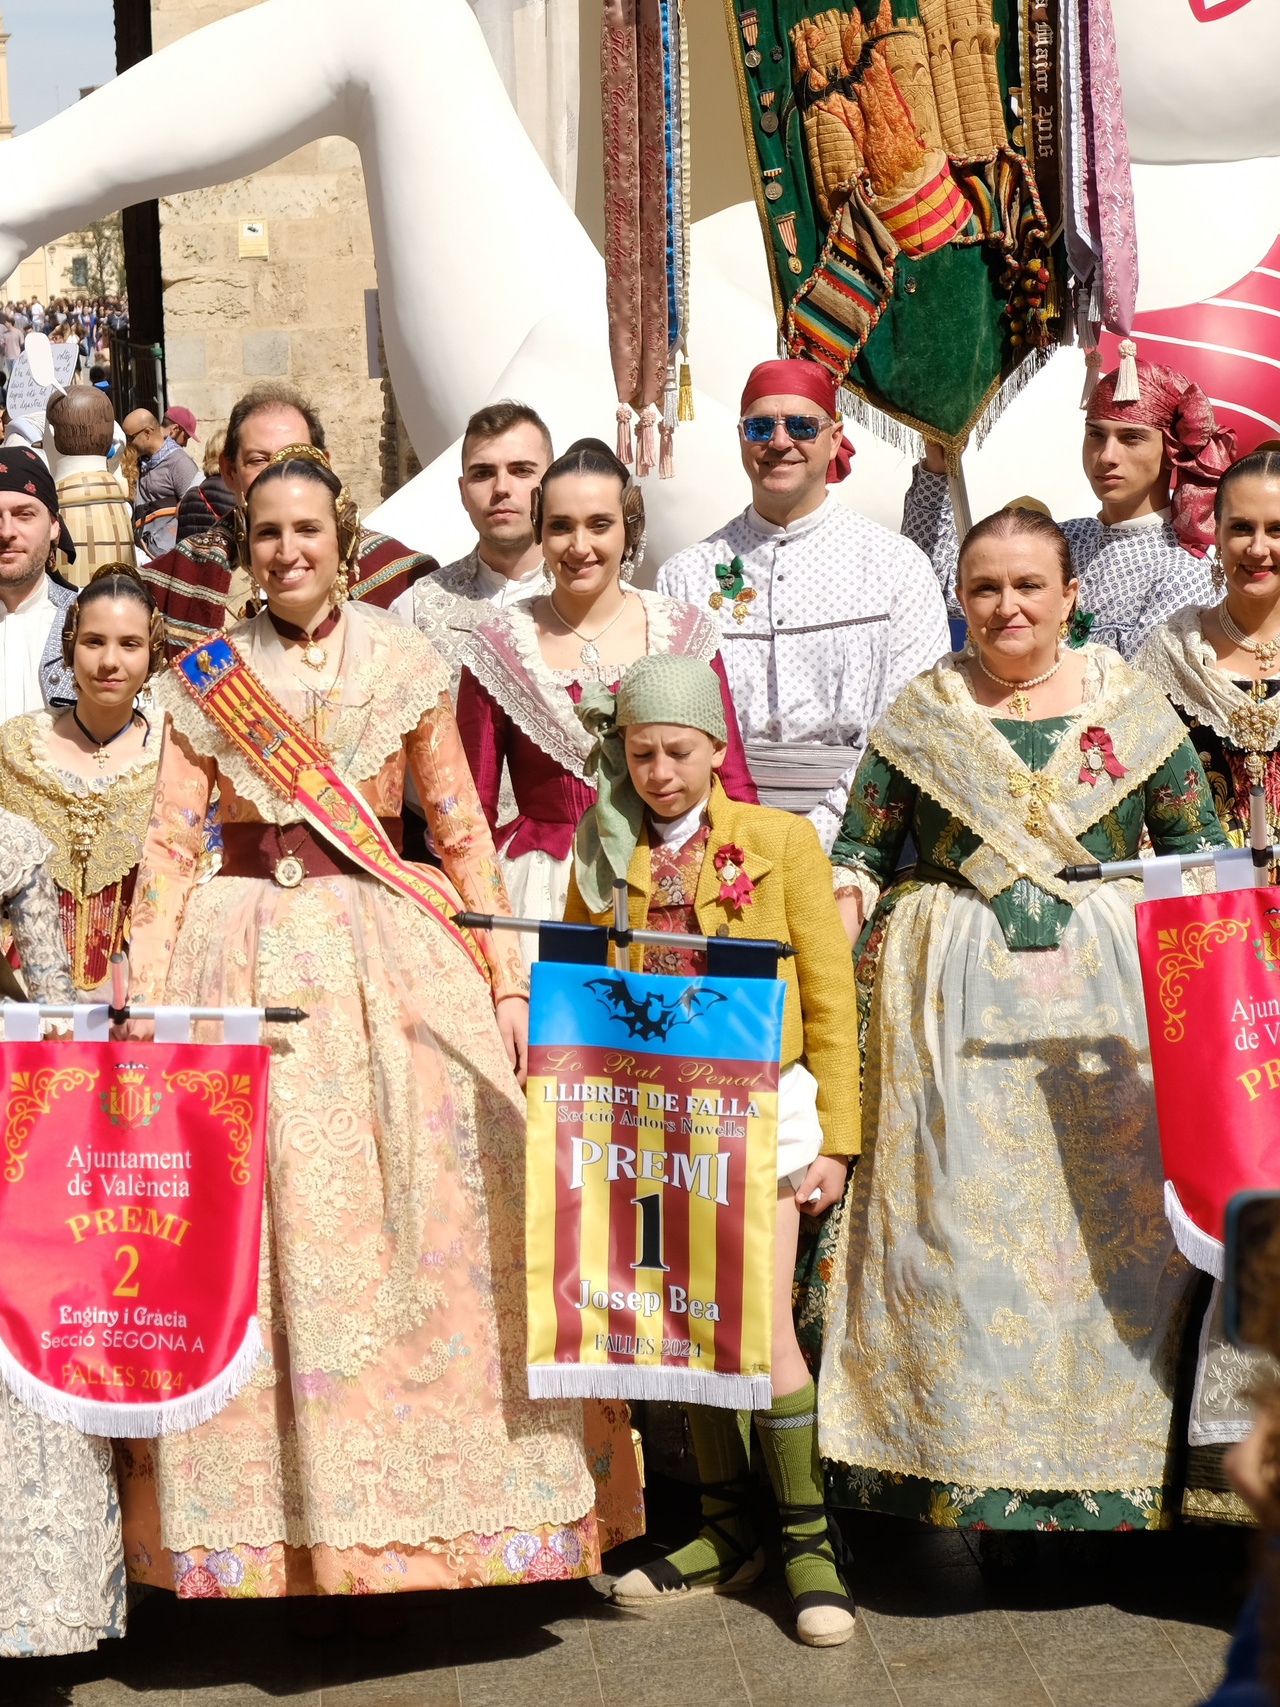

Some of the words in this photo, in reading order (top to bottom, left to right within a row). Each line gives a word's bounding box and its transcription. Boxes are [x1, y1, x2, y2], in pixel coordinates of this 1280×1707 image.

[609, 27, 625, 75] Flor
[643, 24, 655, 112] Fallera
[1032, 22, 1055, 93] Major
[1036, 105, 1054, 158] 2016
[1101, 76, 1116, 169] Romero
[1108, 179, 1125, 247] Prats
[609, 192, 628, 281] Sánchez
[646, 221, 655, 267] 2019
[1234, 1026, 1260, 1051] de
[543, 1050, 583, 1074] Lo
[603, 1052, 663, 1080] Rat
[678, 1061, 765, 1088] Penat
[544, 1083, 639, 1107] LLIBRET
[648, 1090, 679, 1113] DE
[685, 1095, 760, 1118] FALLA
[558, 1105, 615, 1125] Secció
[620, 1113, 676, 1133] Autors
[681, 1117, 745, 1138] Novells
[66, 1145, 192, 1174] Ajuntament
[569, 1135, 731, 1207] PREMI
[67, 1174, 91, 1196] de
[99, 1174, 191, 1198] València
[64, 1205, 193, 1247] PREMI
[629, 1192, 671, 1272] 1
[113, 1245, 140, 1298] 2
[60, 1305, 119, 1329] Enginy
[123, 1306, 129, 1324] i
[133, 1305, 187, 1328] Gràcia
[574, 1279, 662, 1318] Josep
[669, 1284, 721, 1323] Bea
[41, 1330, 95, 1350] Secció
[102, 1331, 187, 1352] SEGONA
[191, 1336, 205, 1353] A
[595, 1332, 657, 1356] FALLES
[661, 1337, 703, 1358] 2024
[62, 1363, 135, 1387] FALLES
[141, 1368, 183, 1390] 2024
